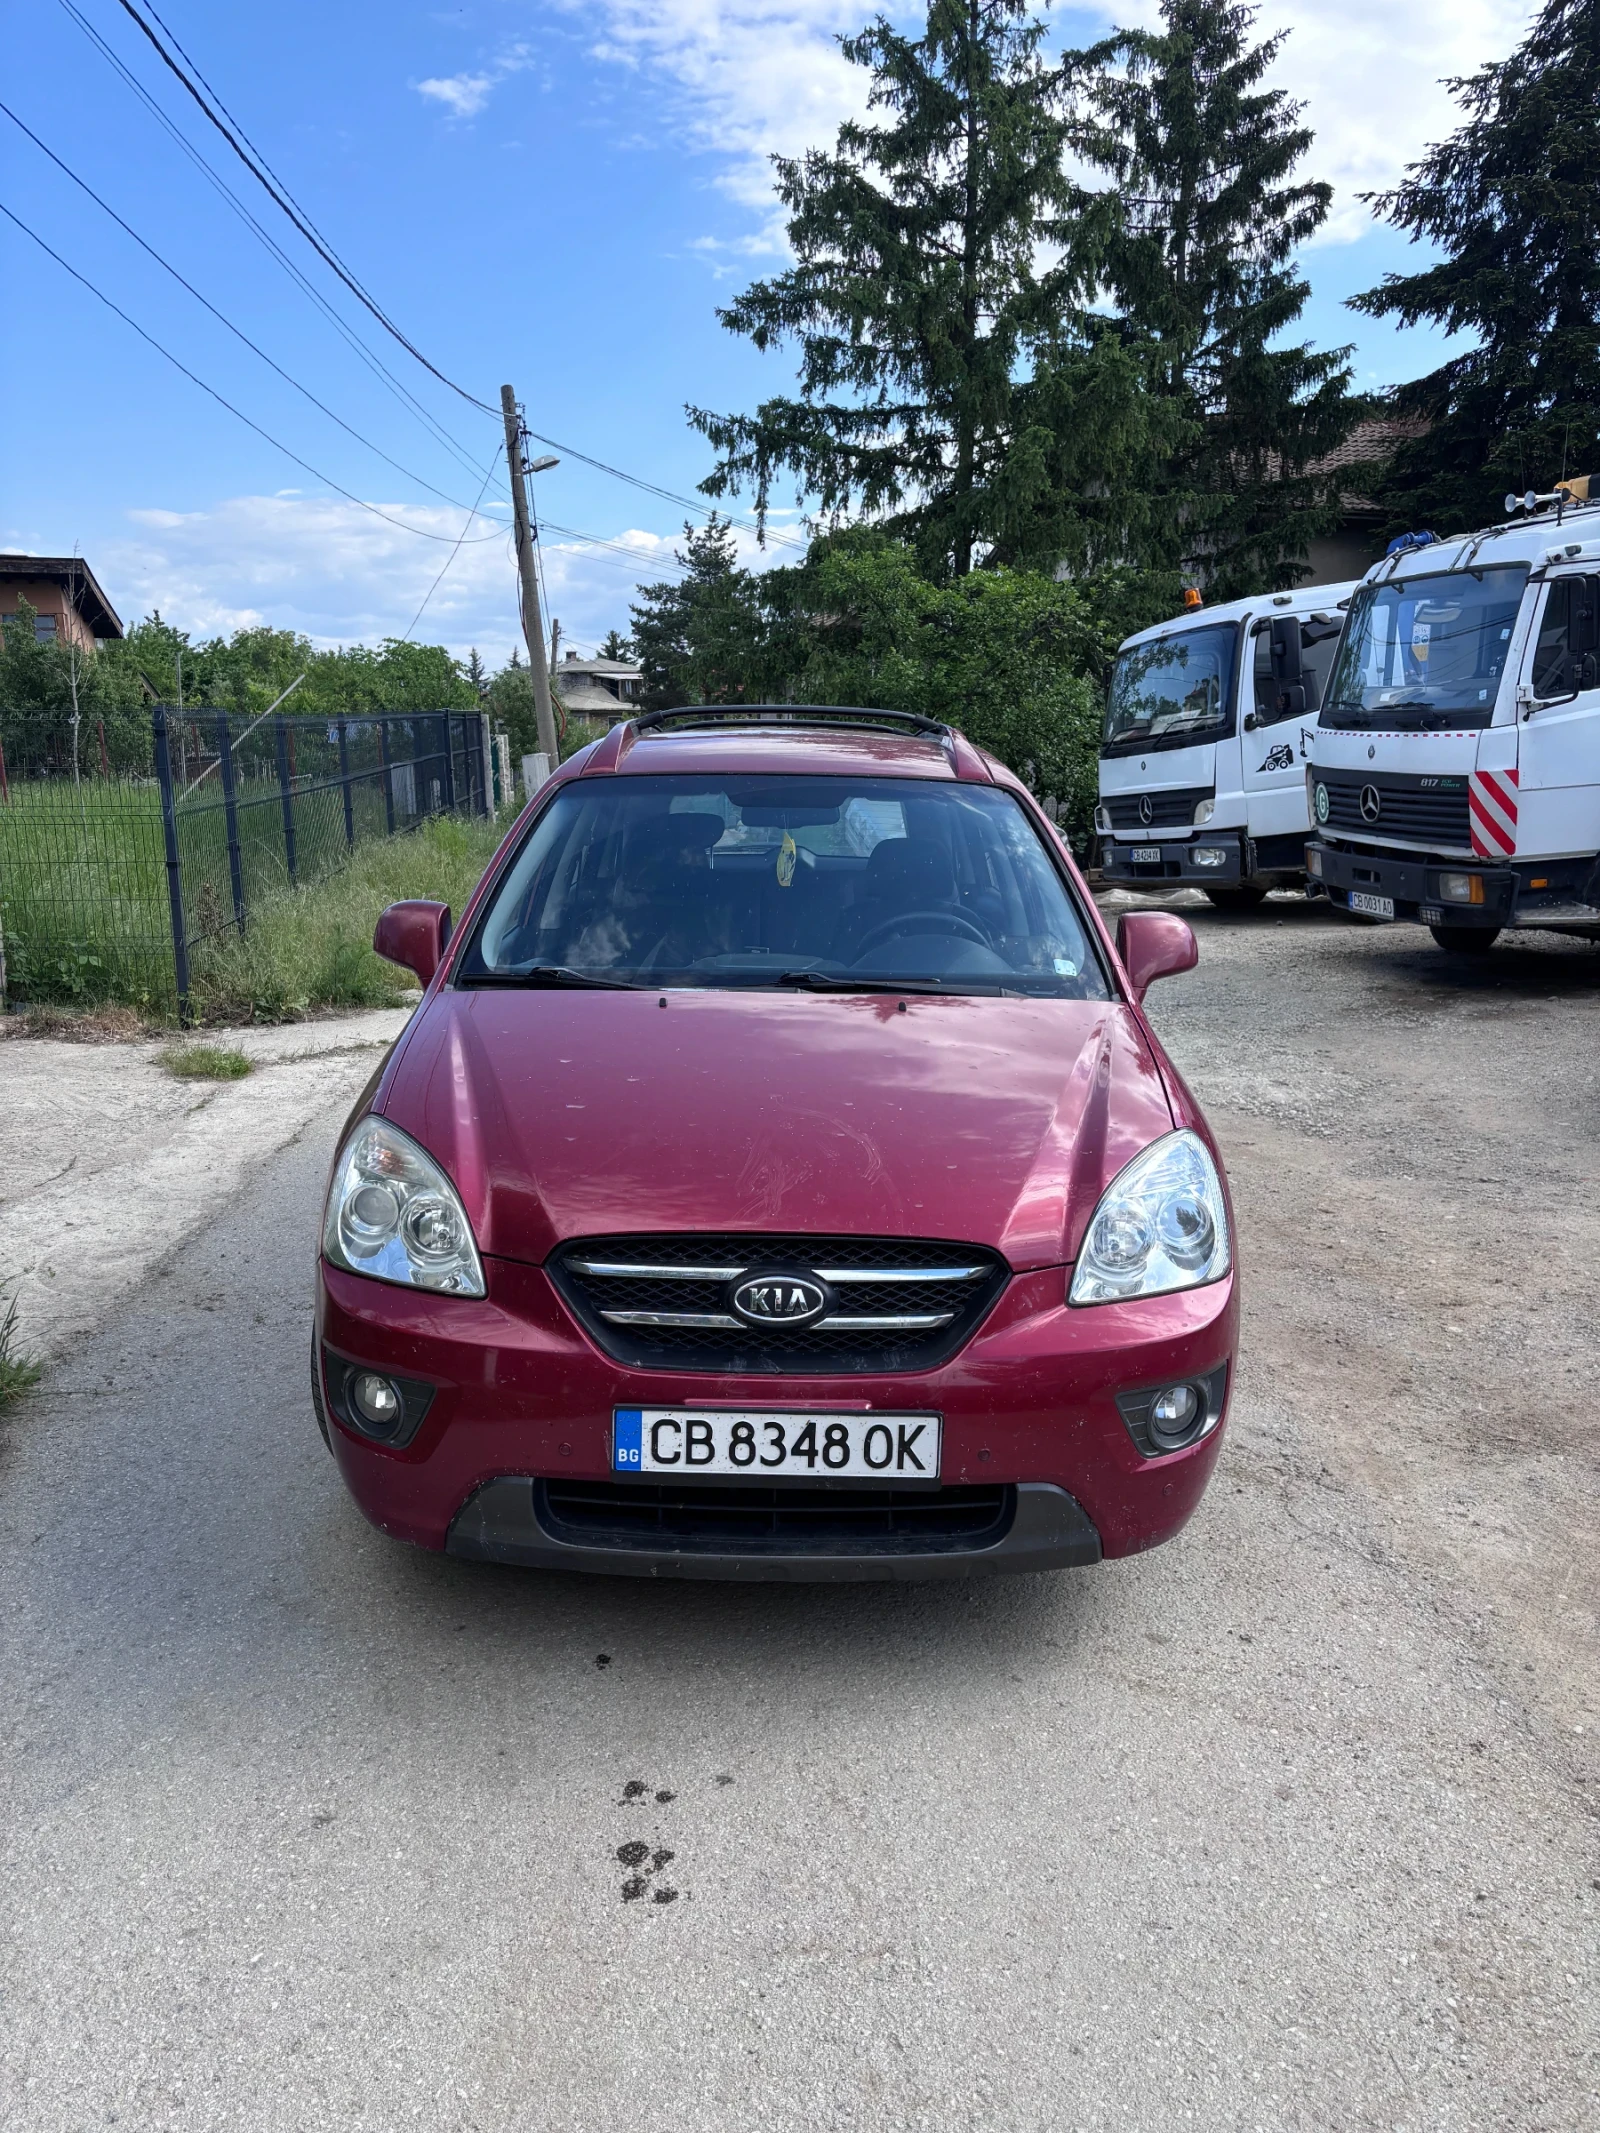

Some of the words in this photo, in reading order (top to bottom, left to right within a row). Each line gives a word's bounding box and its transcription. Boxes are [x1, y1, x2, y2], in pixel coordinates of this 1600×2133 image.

[1420, 778, 1439, 787] 817
[1320, 792, 1326, 814] G
[1134, 850, 1140, 861] CB
[1353, 893, 1363, 908] CB
[1363, 895, 1381, 912] 0031
[1383, 900, 1392, 914] AO
[749, 1287, 809, 1312] KIA
[651, 1418, 716, 1466] CB
[728, 1420, 850, 1469] 8348
[863, 1423, 927, 1471] OK
[618, 1448, 639, 1463] BG
